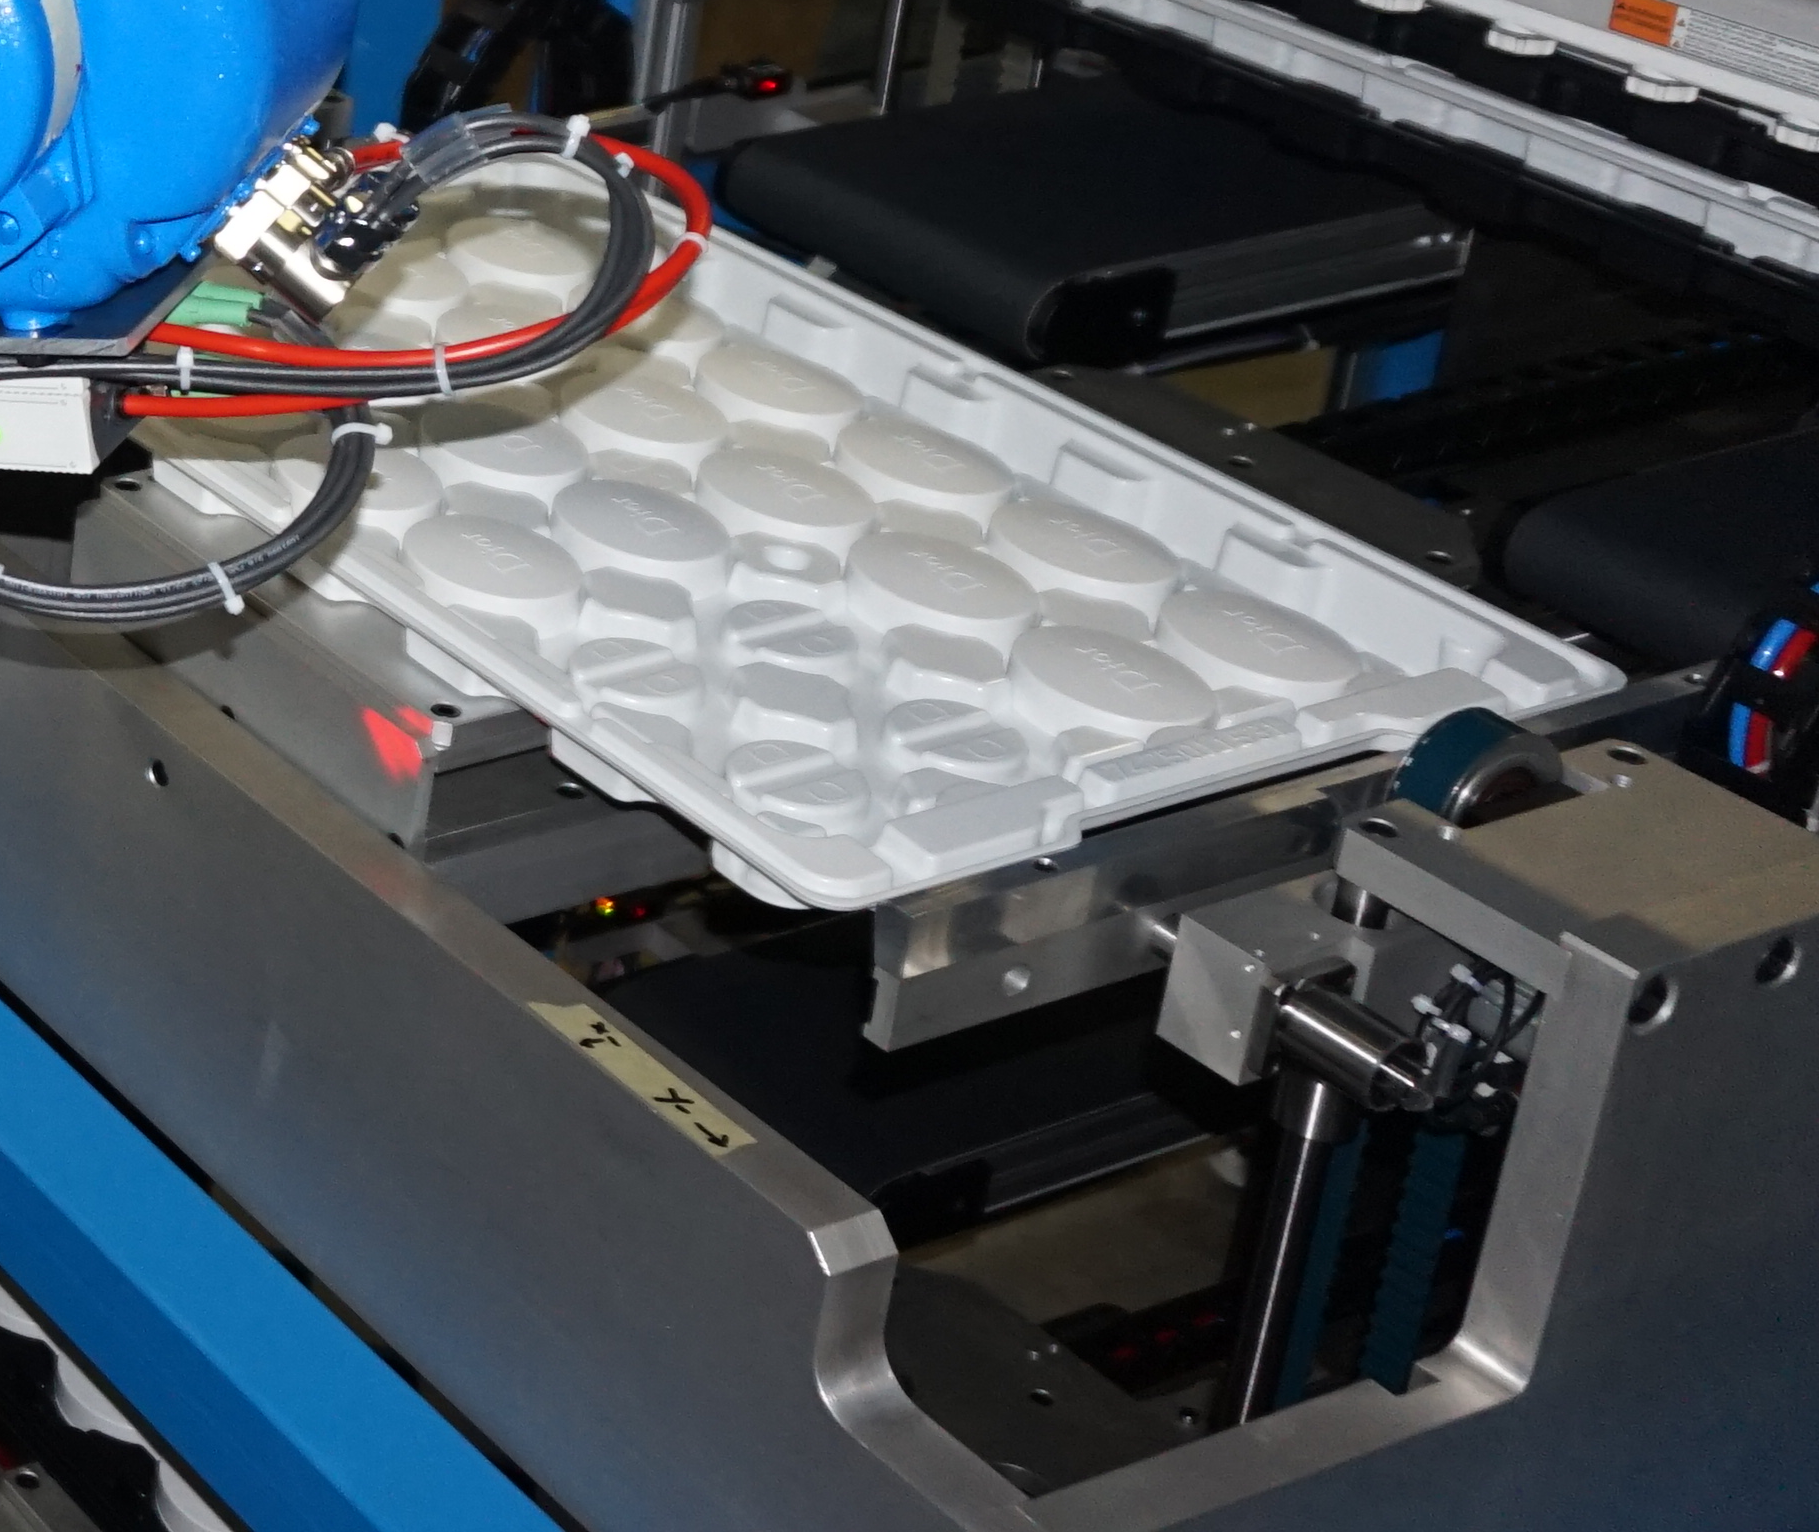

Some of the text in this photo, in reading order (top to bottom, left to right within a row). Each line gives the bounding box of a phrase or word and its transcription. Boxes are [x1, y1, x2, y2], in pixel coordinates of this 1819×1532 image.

[893, 434, 969, 473] Dior
[754, 465, 829, 504] Dior
[610, 497, 681, 536] Dior
[460, 532, 534, 575] Dior
[1049, 518, 1130, 557] Dior
[906, 551, 989, 593] Dior
[1222, 608, 1311, 656] Dior
[1074, 646, 1163, 694] Dior
